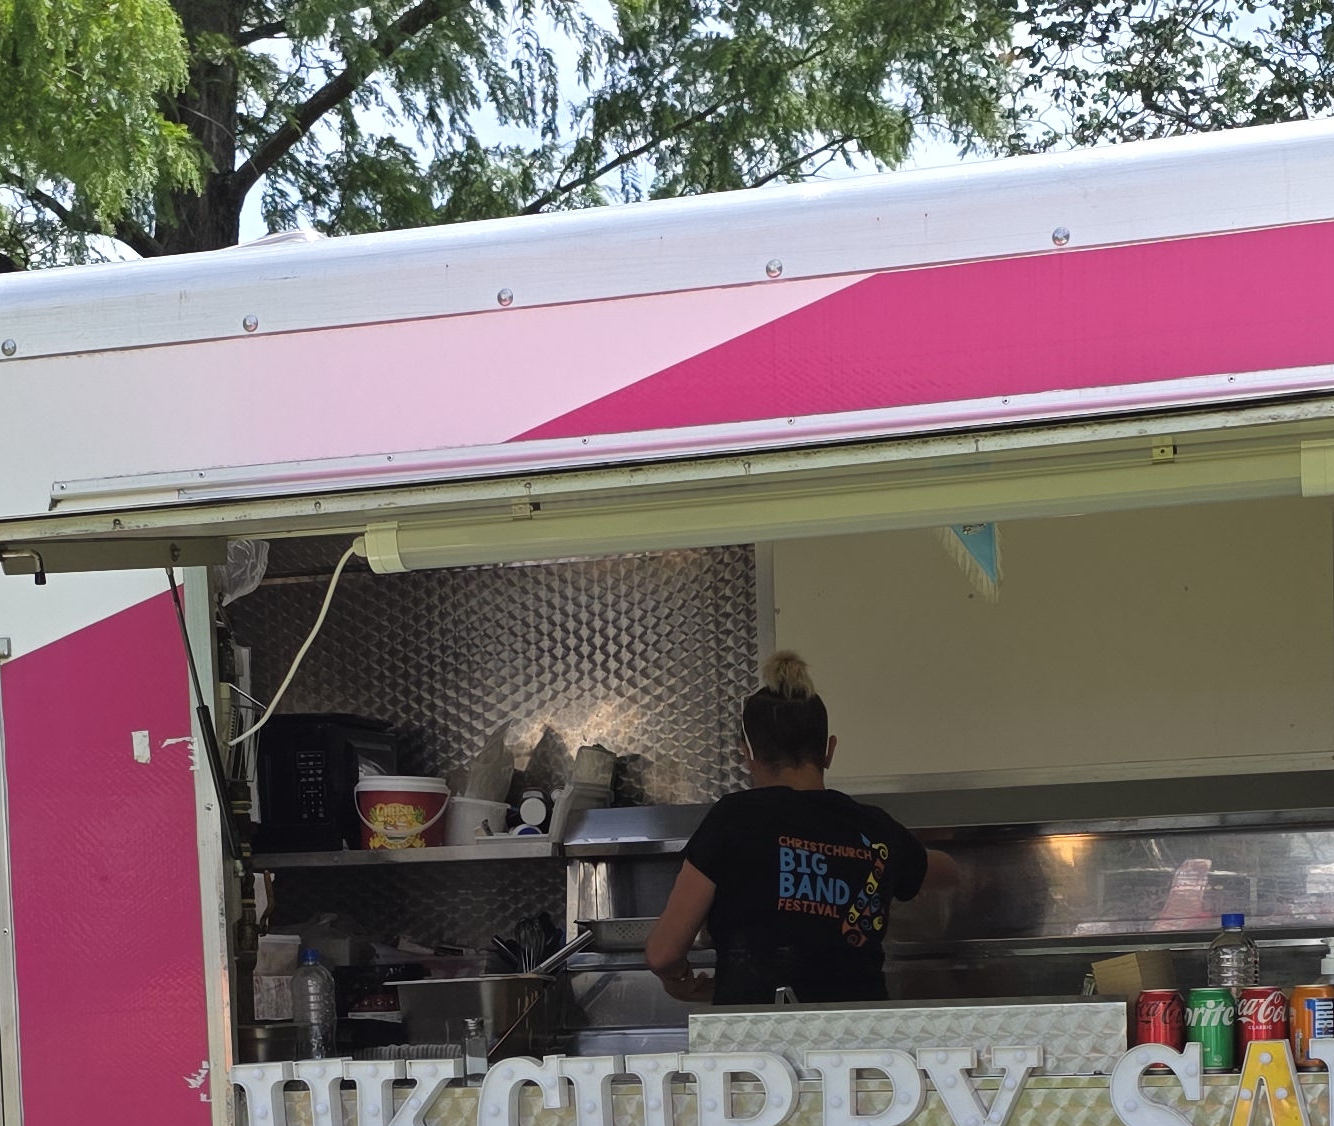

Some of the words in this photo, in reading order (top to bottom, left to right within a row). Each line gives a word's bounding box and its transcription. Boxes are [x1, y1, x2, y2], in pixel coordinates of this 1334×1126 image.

[778, 836, 873, 860] CHRISTCHURCH
[780, 847, 828, 875] BIG
[779, 872, 850, 905] BAND
[778, 899, 840, 918] FESTIVAL
